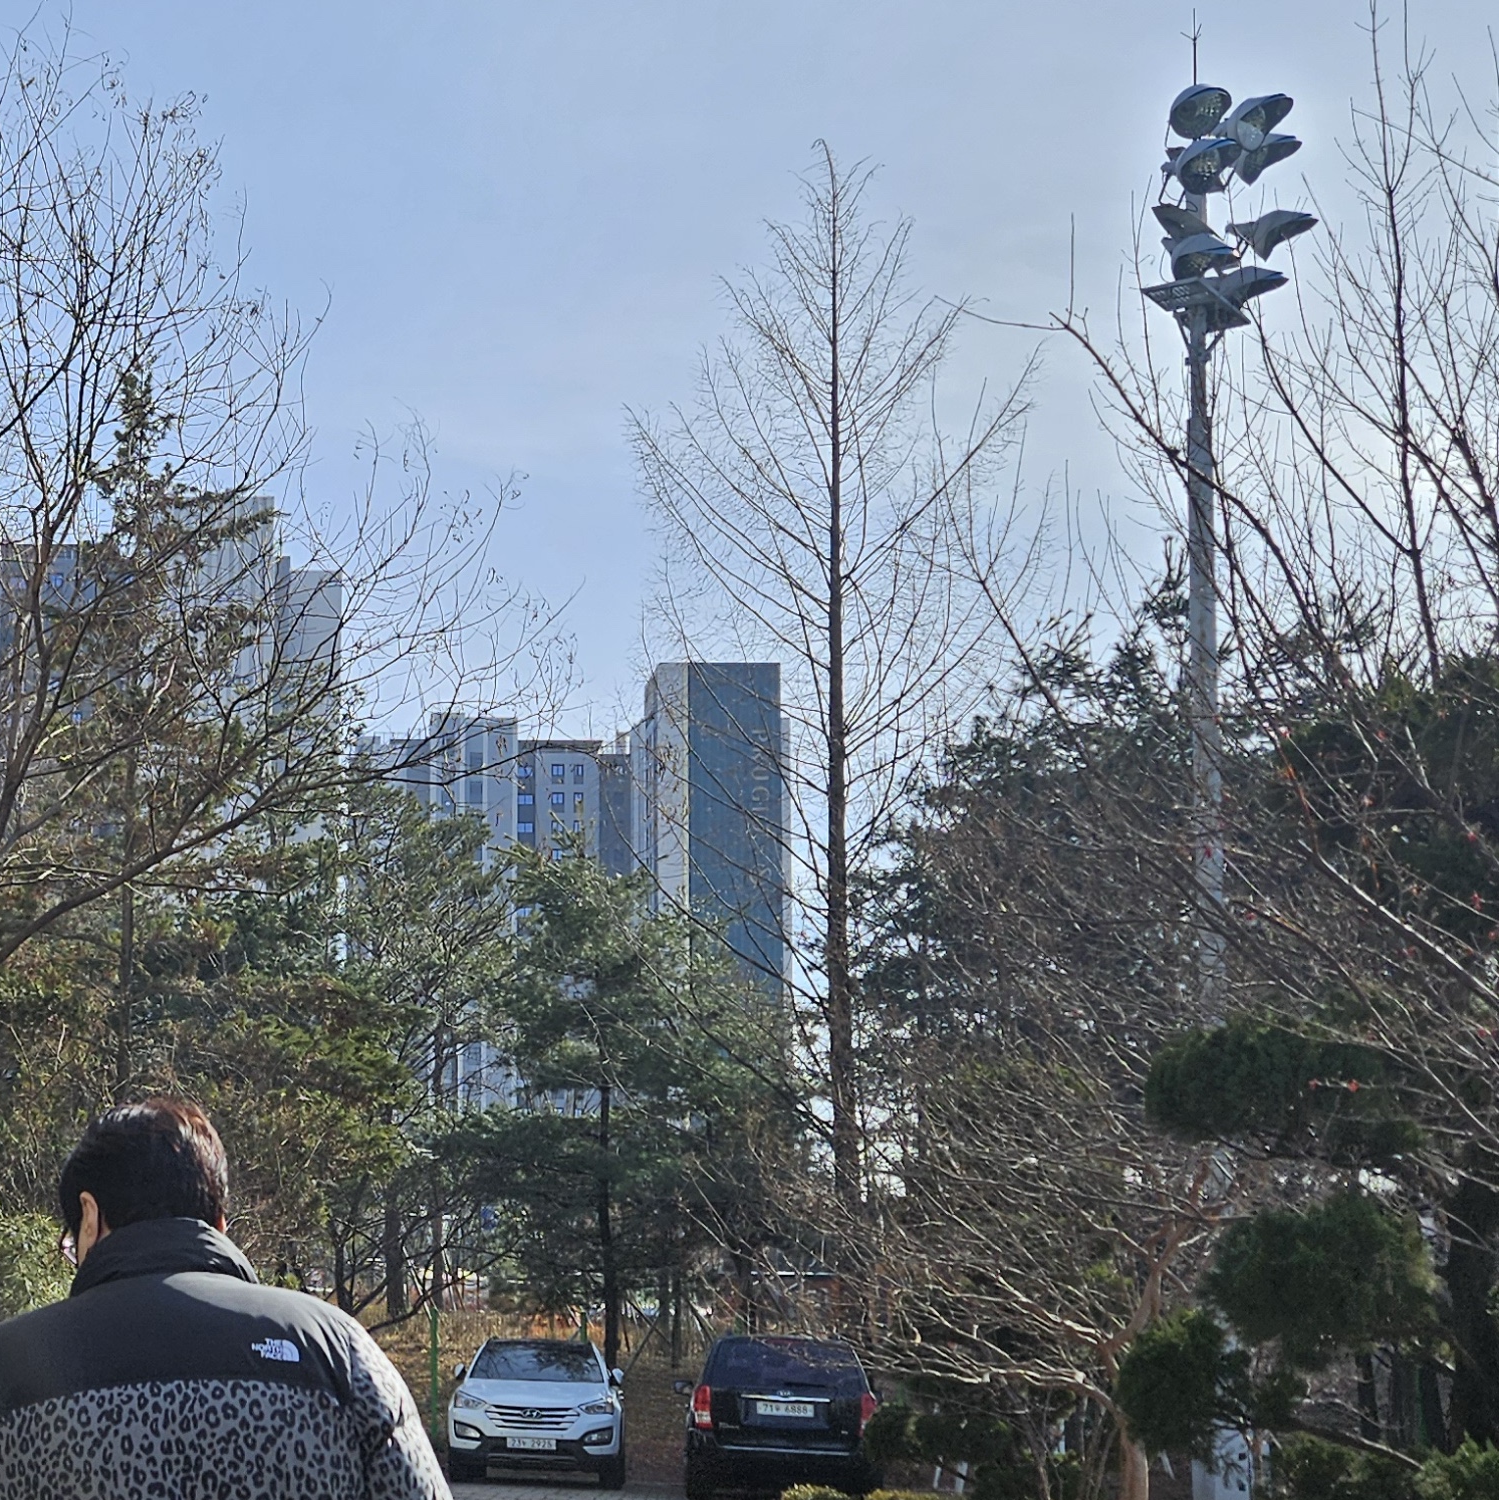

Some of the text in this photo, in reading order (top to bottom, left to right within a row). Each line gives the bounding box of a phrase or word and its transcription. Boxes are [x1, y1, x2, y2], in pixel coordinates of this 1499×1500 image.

[750, 727, 771, 836] PRUGI
[265, 1337, 282, 1346] THE
[251, 1342, 282, 1354] NORTH
[260, 1350, 282, 1361] FACE
